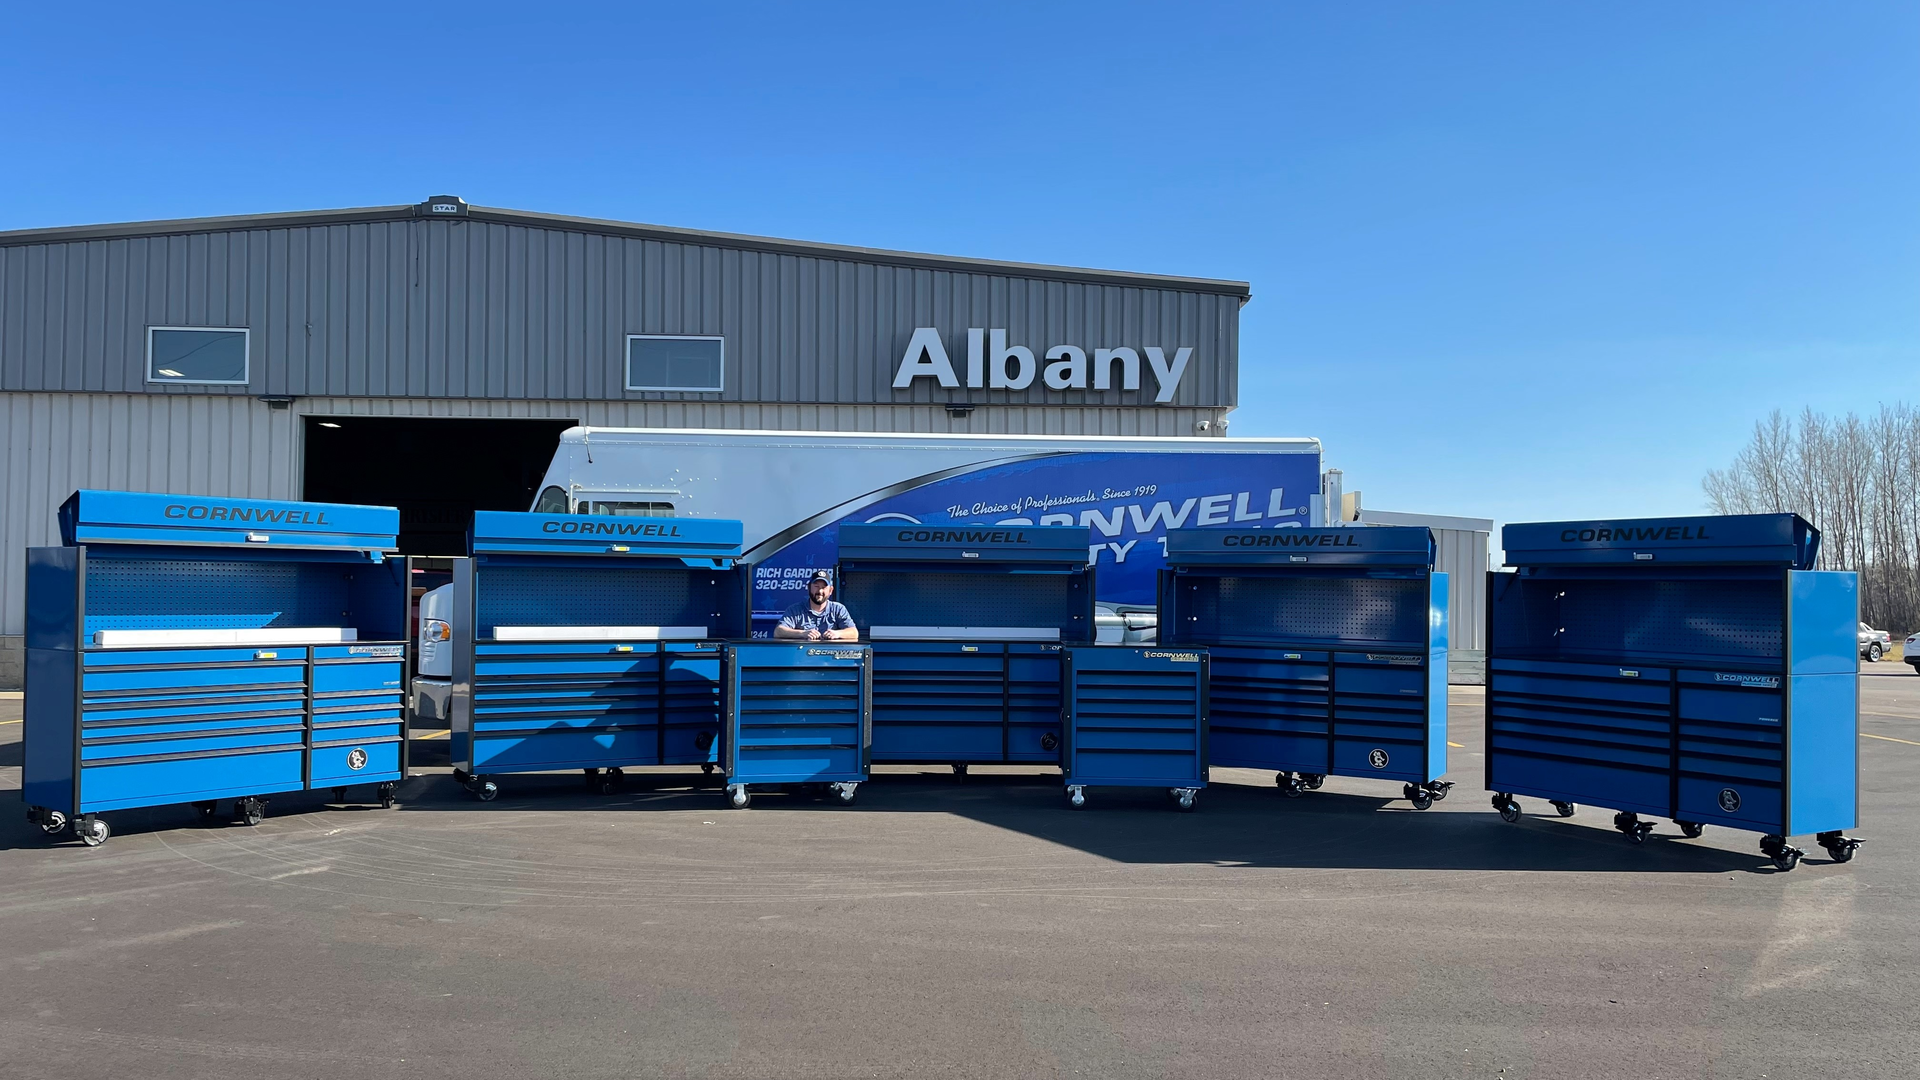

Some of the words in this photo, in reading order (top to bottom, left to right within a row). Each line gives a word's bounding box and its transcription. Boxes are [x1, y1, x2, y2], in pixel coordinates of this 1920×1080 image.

[892, 327, 1194, 403] Albany
[947, 505, 969, 518] The
[971, 502, 1009, 515] Choice
[1011, 499, 1023, 514] of
[1102, 487, 1132, 500] Since
[1134, 484, 1157, 496] 1919
[164, 504, 329, 525] CORNWELL
[969, 487, 1296, 537] NWELL
[542, 521, 682, 538] CORNWELL
[897, 530, 1028, 544] CORNWELL
[1560, 525, 1711, 543] CORNWELL
[1223, 535, 1356, 547] CORNWELL
[756, 567, 781, 578] RICH
[784, 568, 833, 579] GARDR
[756, 580, 809, 590] 320-250-
[751, 631, 768, 639] 244
[1722, 675, 1779, 683] CORNWELL
